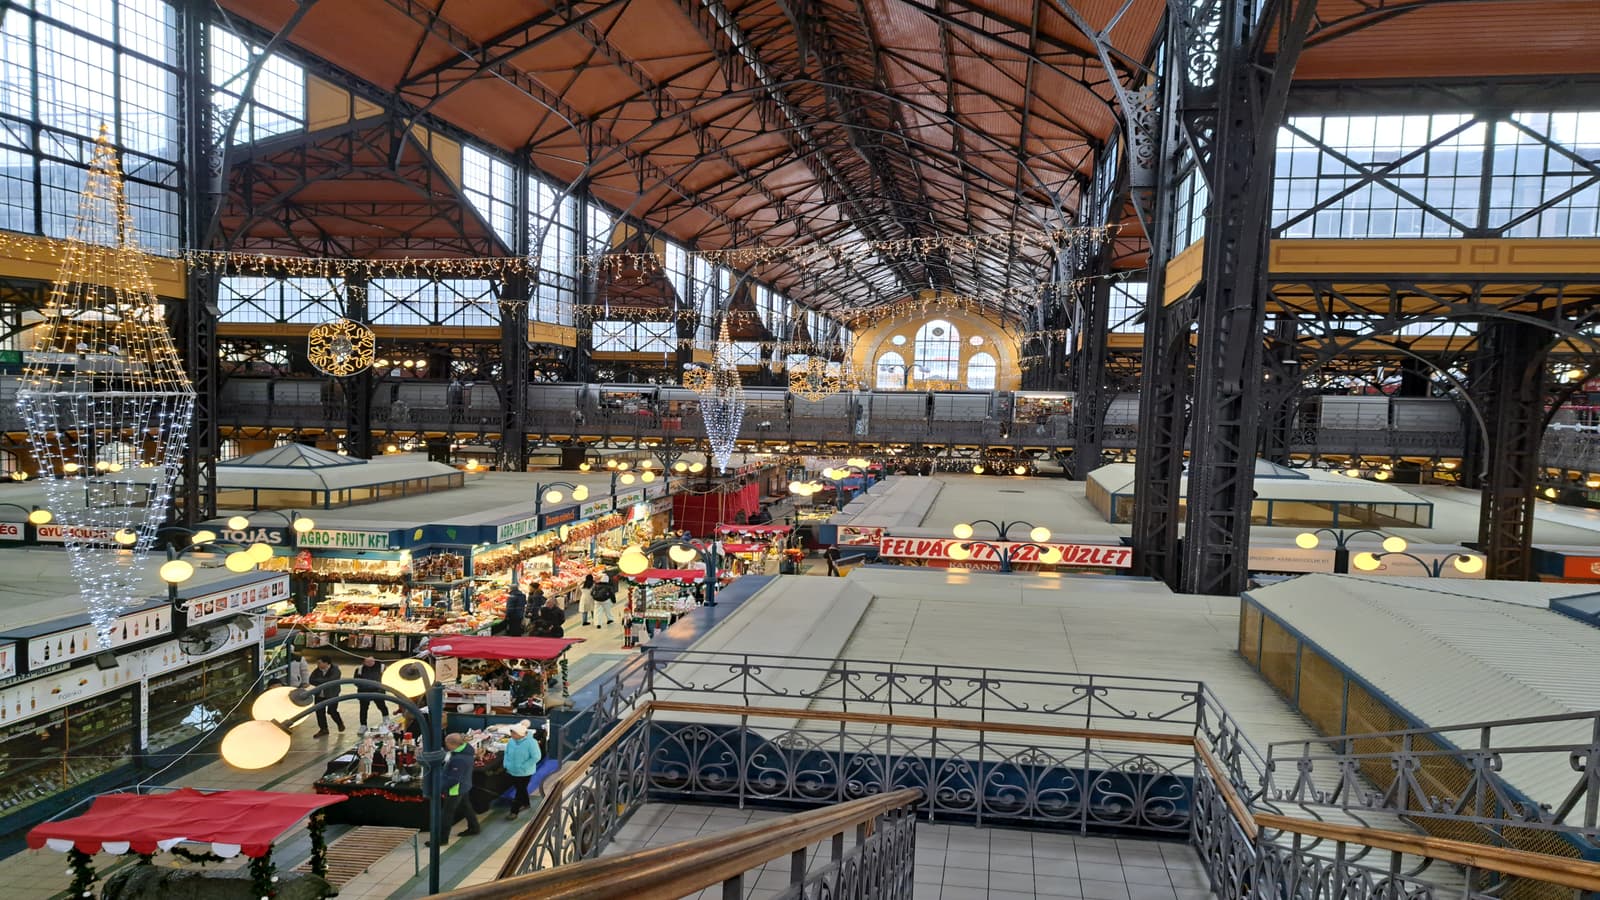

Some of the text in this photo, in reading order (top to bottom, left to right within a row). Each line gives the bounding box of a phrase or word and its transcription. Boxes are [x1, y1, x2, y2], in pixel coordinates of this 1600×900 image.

[220, 528, 282, 544] TOJÁS
[300, 531, 389, 548] AGRO-FRUIT KFT.
